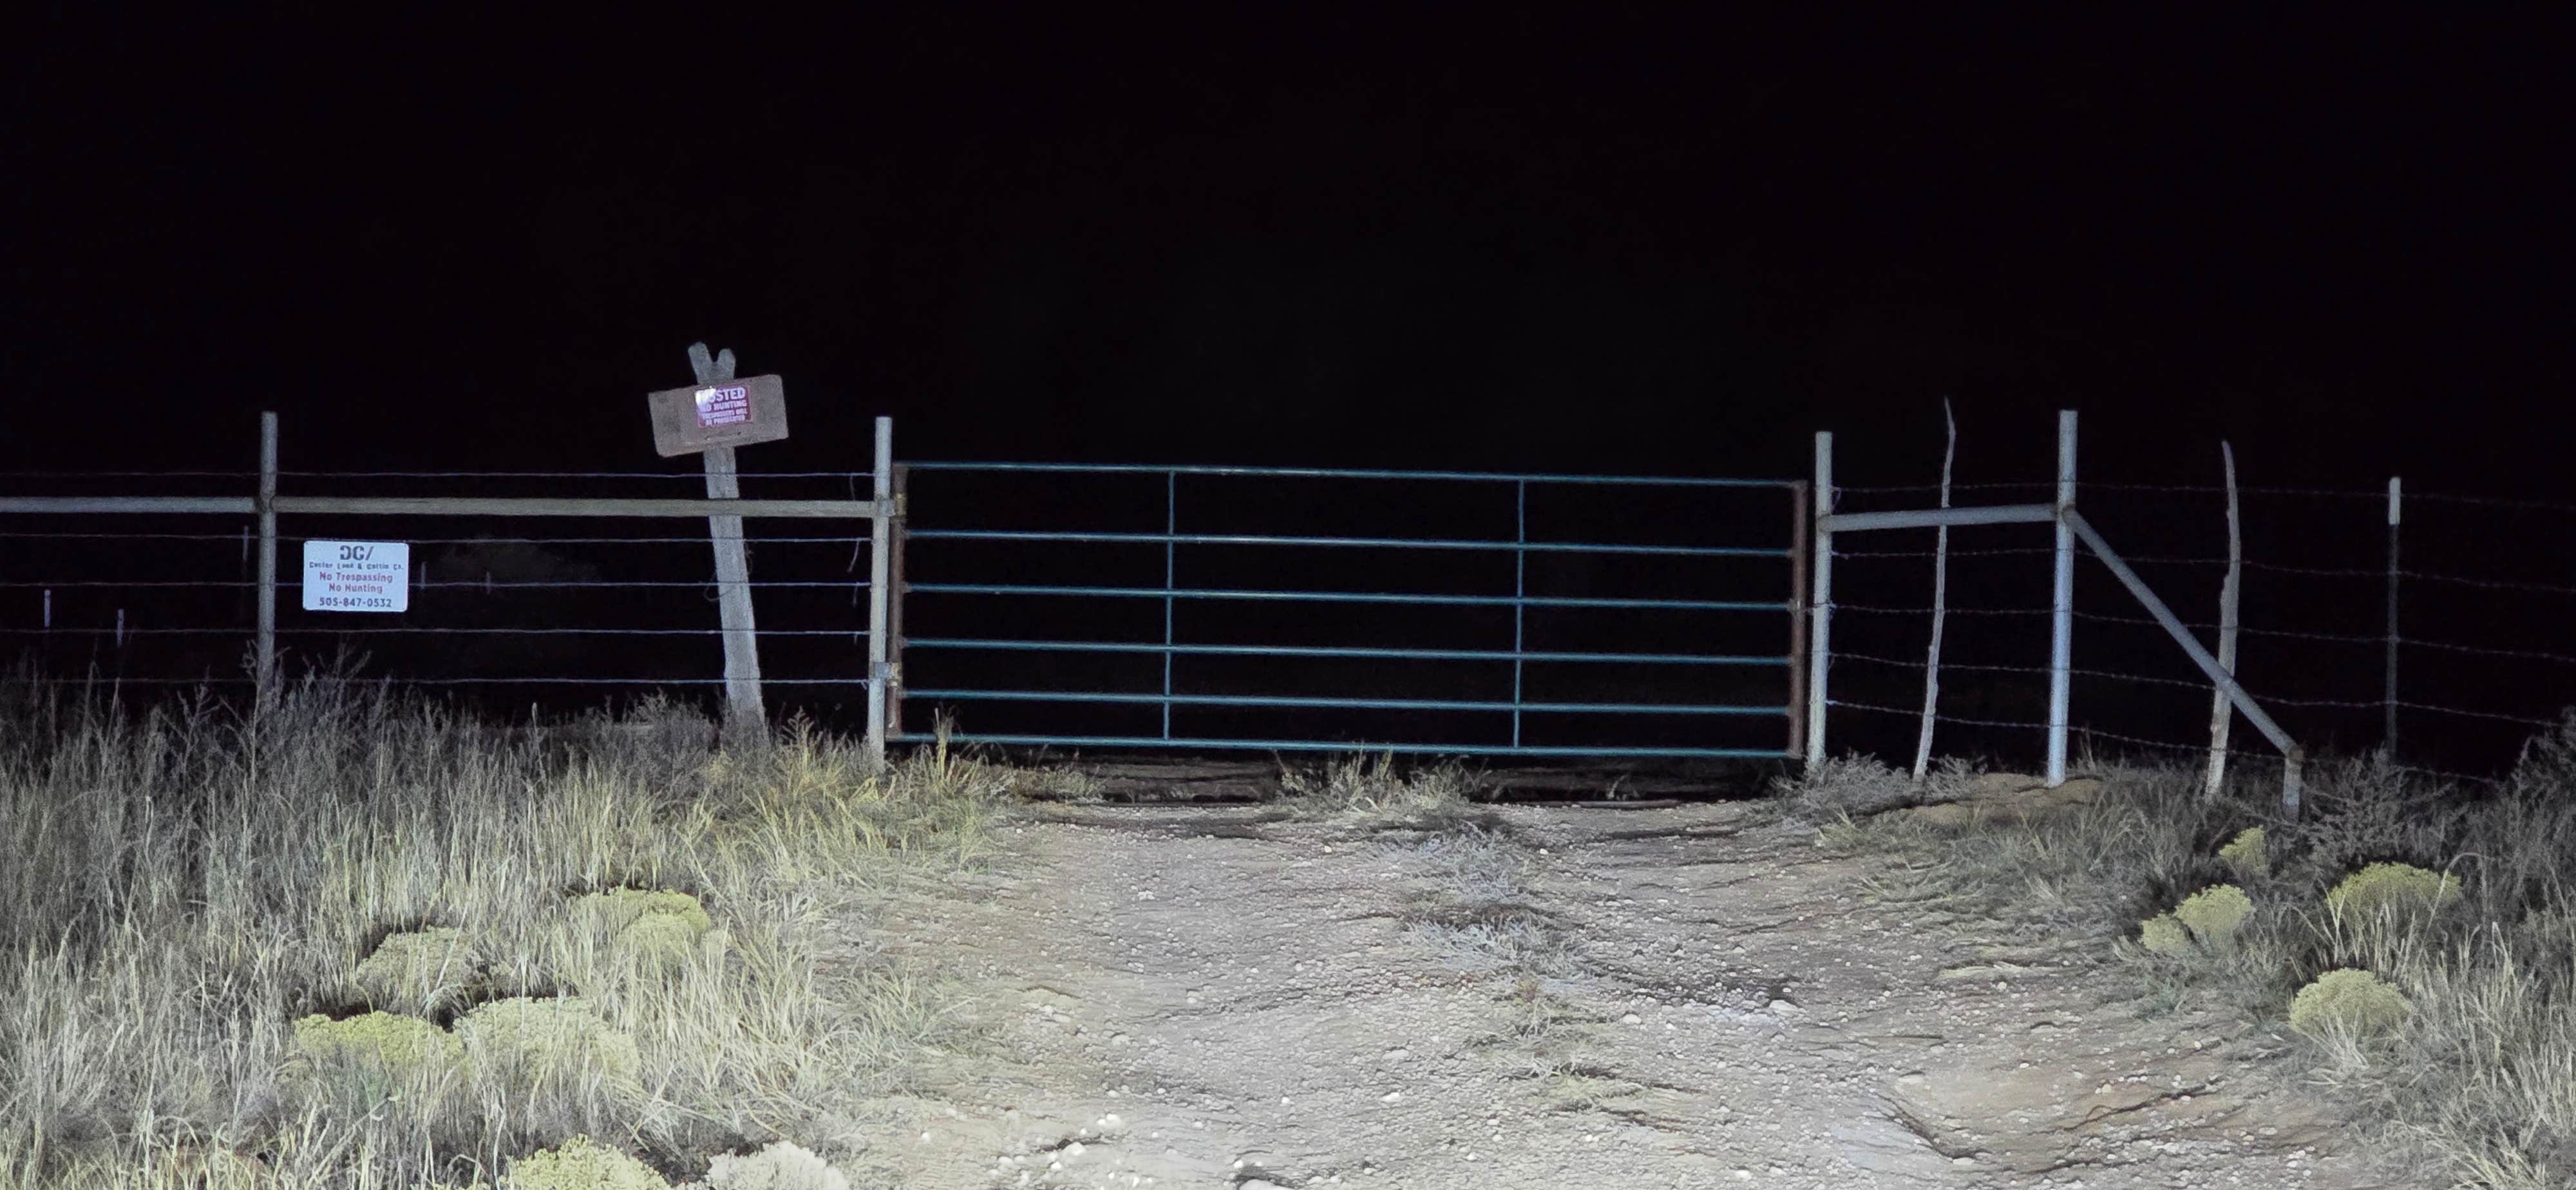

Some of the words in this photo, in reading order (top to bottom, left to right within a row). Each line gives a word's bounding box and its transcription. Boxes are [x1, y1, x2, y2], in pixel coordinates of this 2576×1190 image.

[713, 399, 748, 410] HUNTING
[319, 571, 332, 581] No
[335, 571, 393, 583] Trespassing
[328, 583, 342, 592] No
[344, 583, 383, 594] Hunting
[319, 596, 392, 608] 505-847-0532
